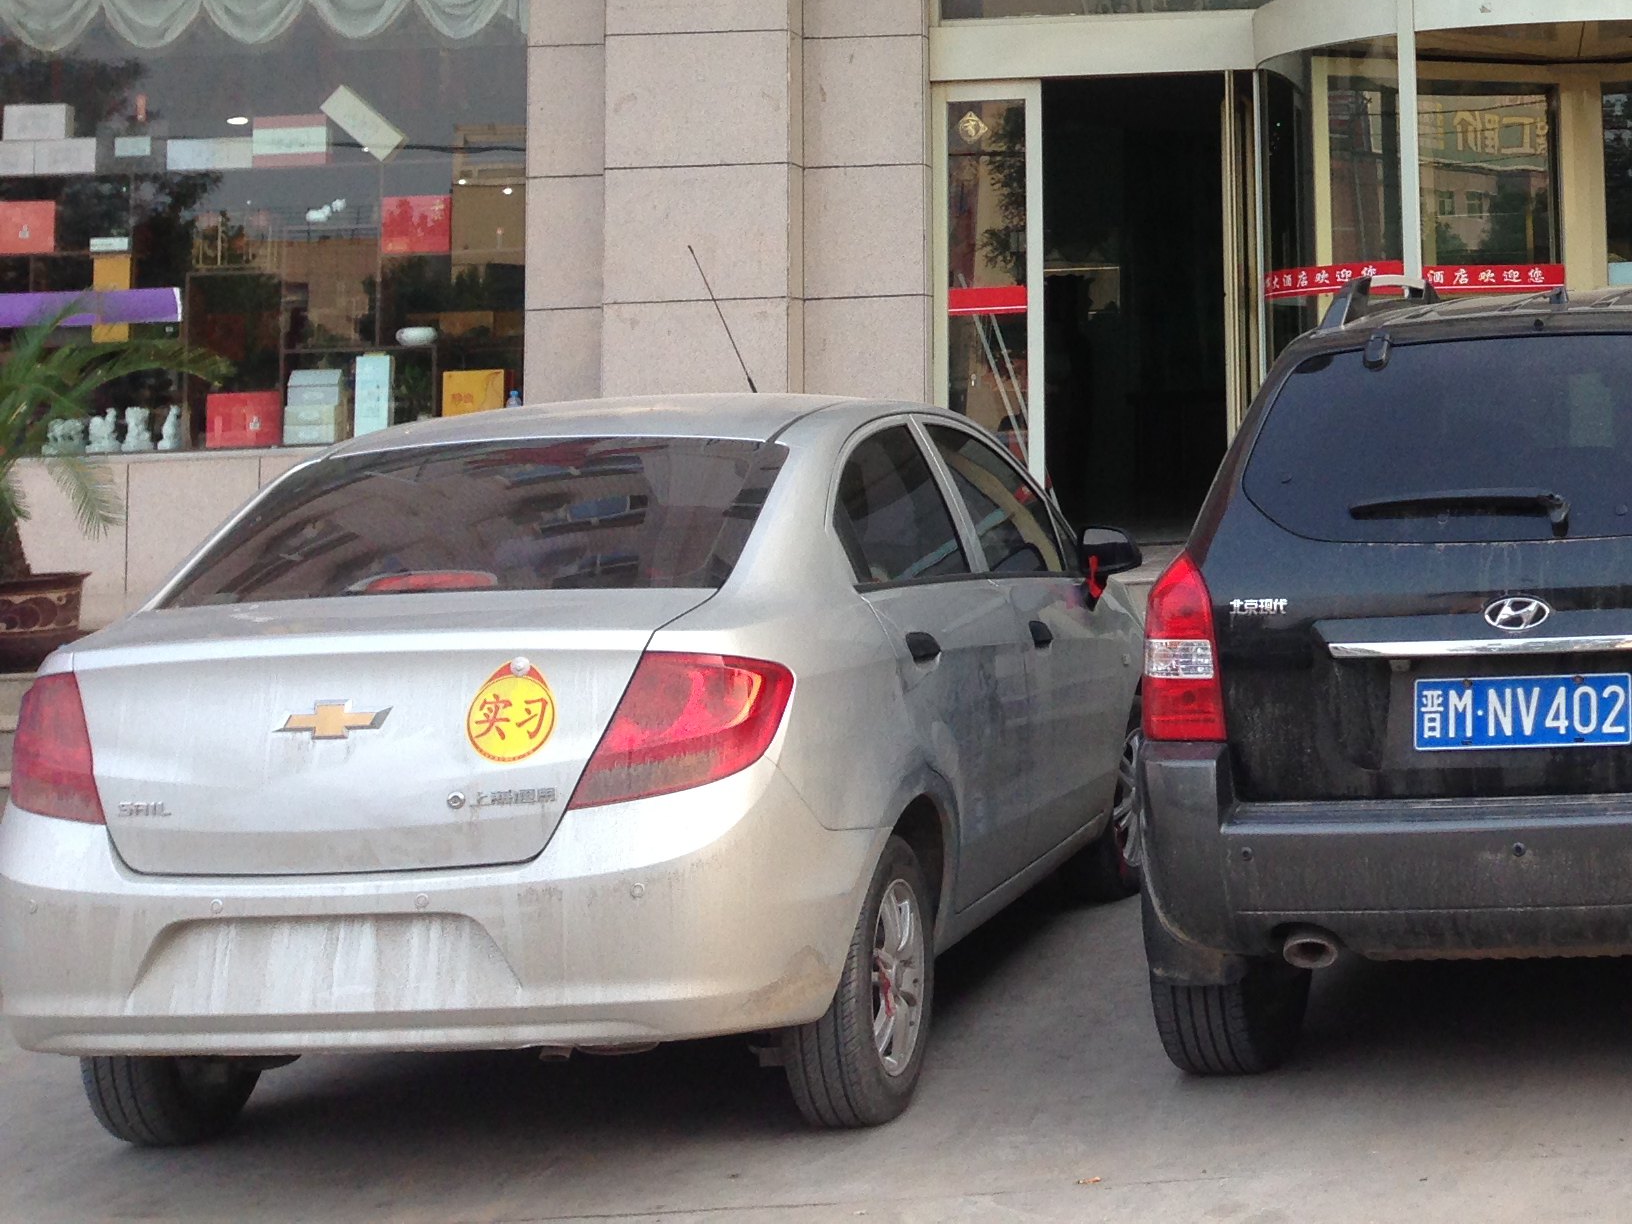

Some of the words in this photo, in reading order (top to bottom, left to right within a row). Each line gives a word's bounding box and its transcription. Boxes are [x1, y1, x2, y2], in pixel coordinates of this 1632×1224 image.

[1426, 267, 1545, 284] 酒店欢迎您
[1229, 598, 1288, 615] 北京现代
[474, 693, 549, 741] 实习
